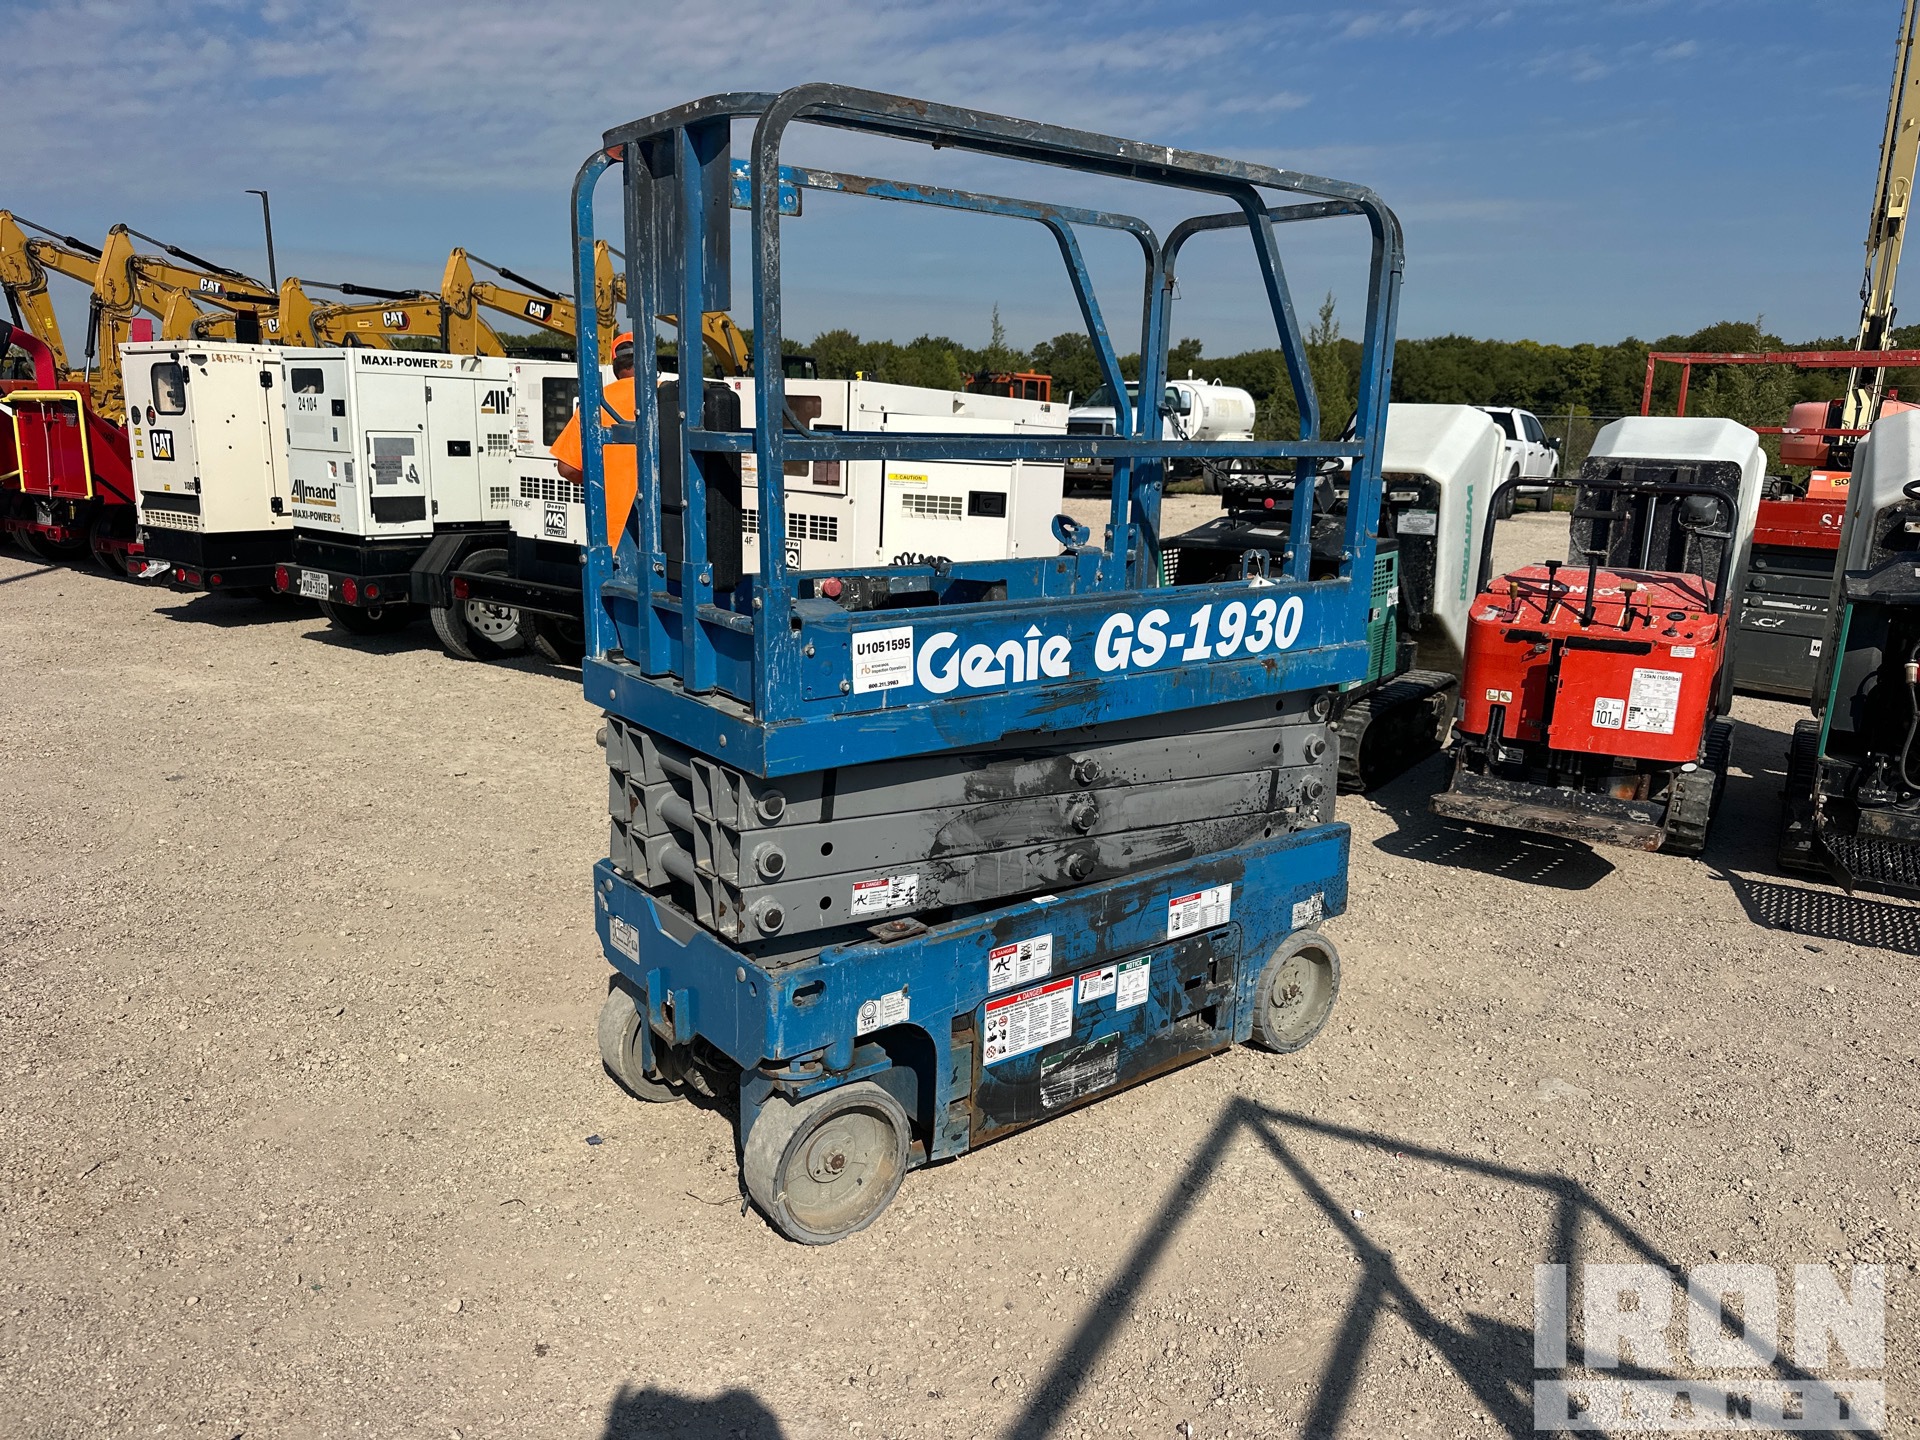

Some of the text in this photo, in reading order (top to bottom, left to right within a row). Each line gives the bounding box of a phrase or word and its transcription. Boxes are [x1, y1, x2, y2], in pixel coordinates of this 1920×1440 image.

[200, 278, 221, 293] CAT
[529, 301, 546, 319] CAT
[383, 311, 403, 327] CAT
[361, 354, 438, 369] MAXI-POWER
[298, 396, 318, 412] 24104
[152, 432, 171, 458] CAT
[291, 479, 336, 504] Allmand
[511, 499, 523, 508] TIER
[292, 508, 333, 523] MAXI-POWER
[545, 511, 566, 529] MQ
[546, 528, 566, 536] POWER
[744, 536, 754, 545] 4F
[857, 637, 911, 655] U1051595
[917, 596, 1304, 694] Genie GS-1930
[1596, 710, 1612, 725] 101
[996, 946, 1016, 956] DANGER
[1126, 959, 1142, 969] NOTICE
[1022, 988, 1043, 1000] DANGER
